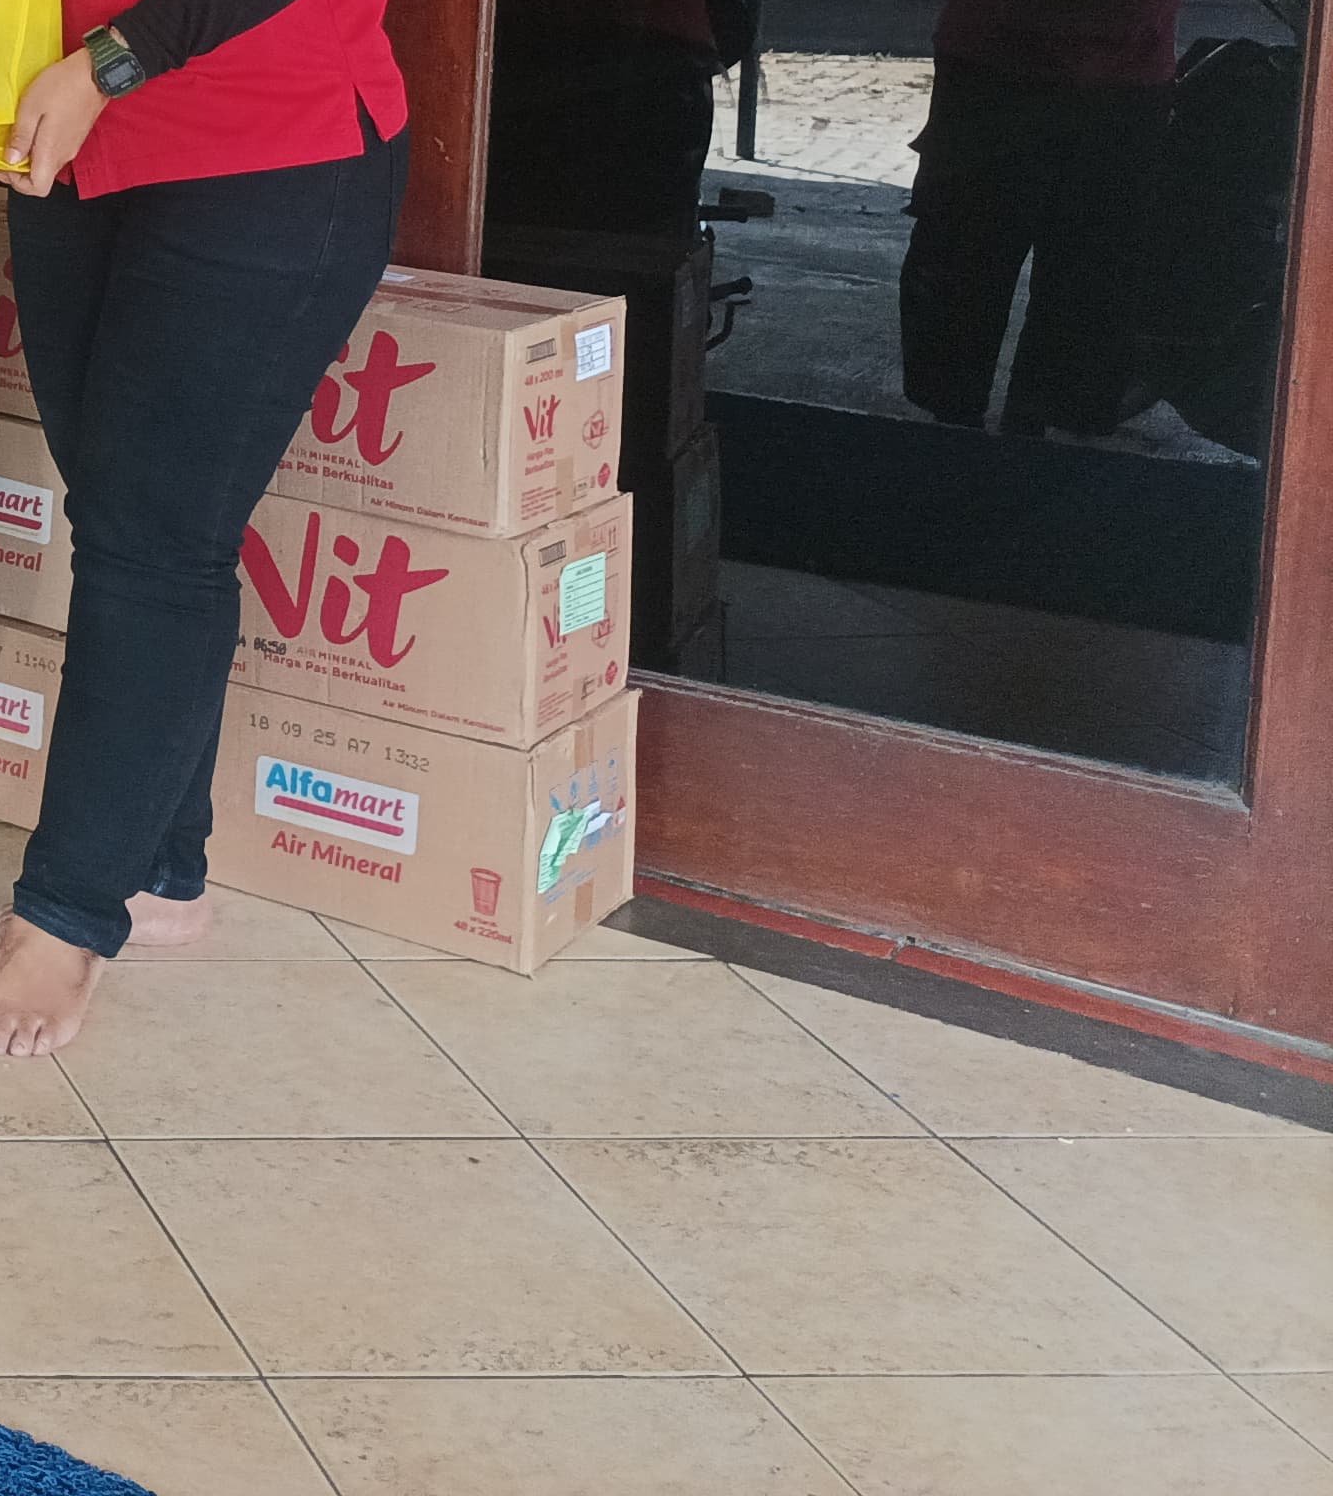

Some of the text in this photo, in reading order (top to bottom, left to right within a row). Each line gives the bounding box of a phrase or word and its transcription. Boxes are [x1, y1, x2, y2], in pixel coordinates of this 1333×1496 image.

[0, 378, 33, 393] Berku
[311, 330, 437, 467] it
[523, 394, 561, 441] Vit
[297, 462, 318, 475] Pas
[322, 467, 394, 491] Berkualitas
[238, 511, 450, 669] Vit
[15, 651, 57, 674] 11:40
[264, 651, 407, 693] Harga Pas Berkualitas
[250, 714, 430, 773] 18 09 25 A7 13:32
[266, 763, 405, 822] Alfamart
[271, 830, 402, 883] Air Mineral
